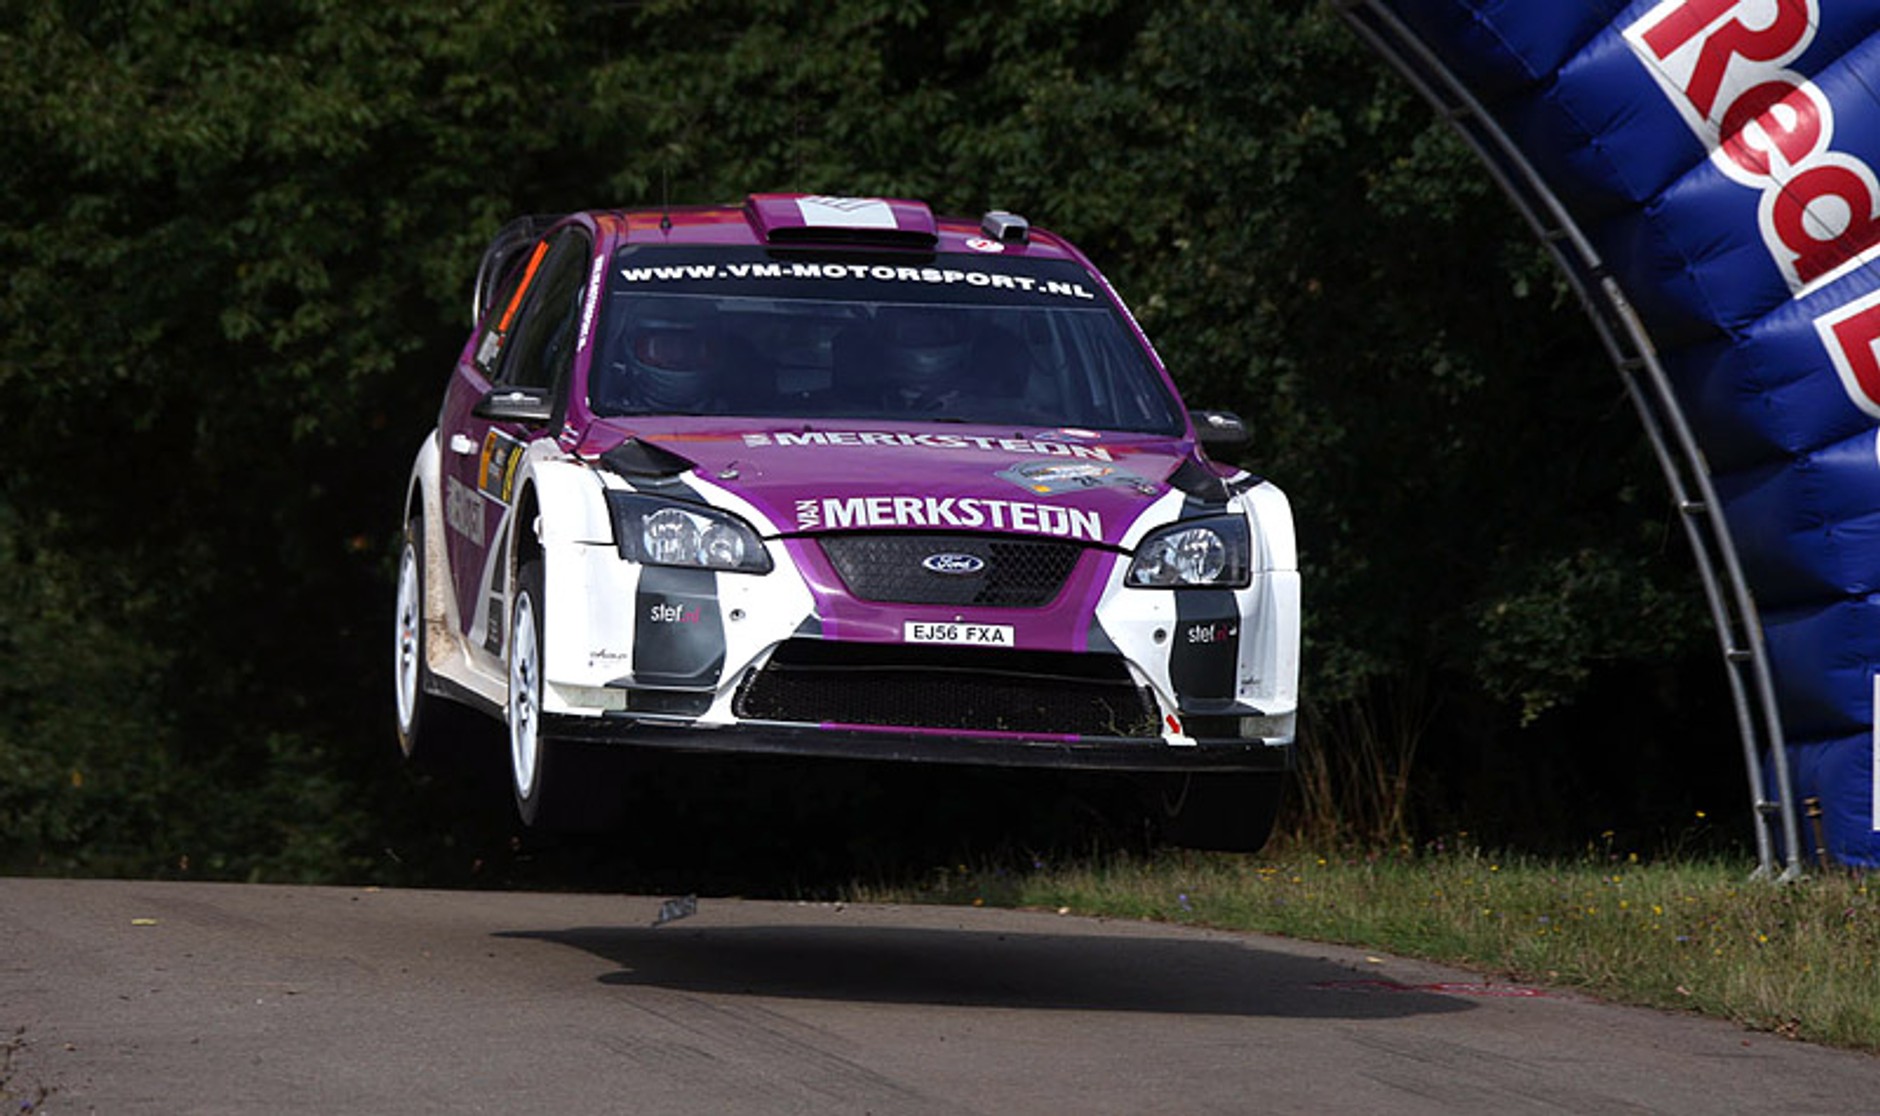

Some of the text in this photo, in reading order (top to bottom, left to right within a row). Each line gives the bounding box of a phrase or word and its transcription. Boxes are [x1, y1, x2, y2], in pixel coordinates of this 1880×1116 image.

[1638, 0, 1880, 286] Red
[621, 263, 1095, 299] WWW.VM-MOTORSPORT.NL
[795, 499, 820, 531] VAN
[936, 555, 973, 570] Ford
[913, 624, 1005, 642] EJ56 FXA
